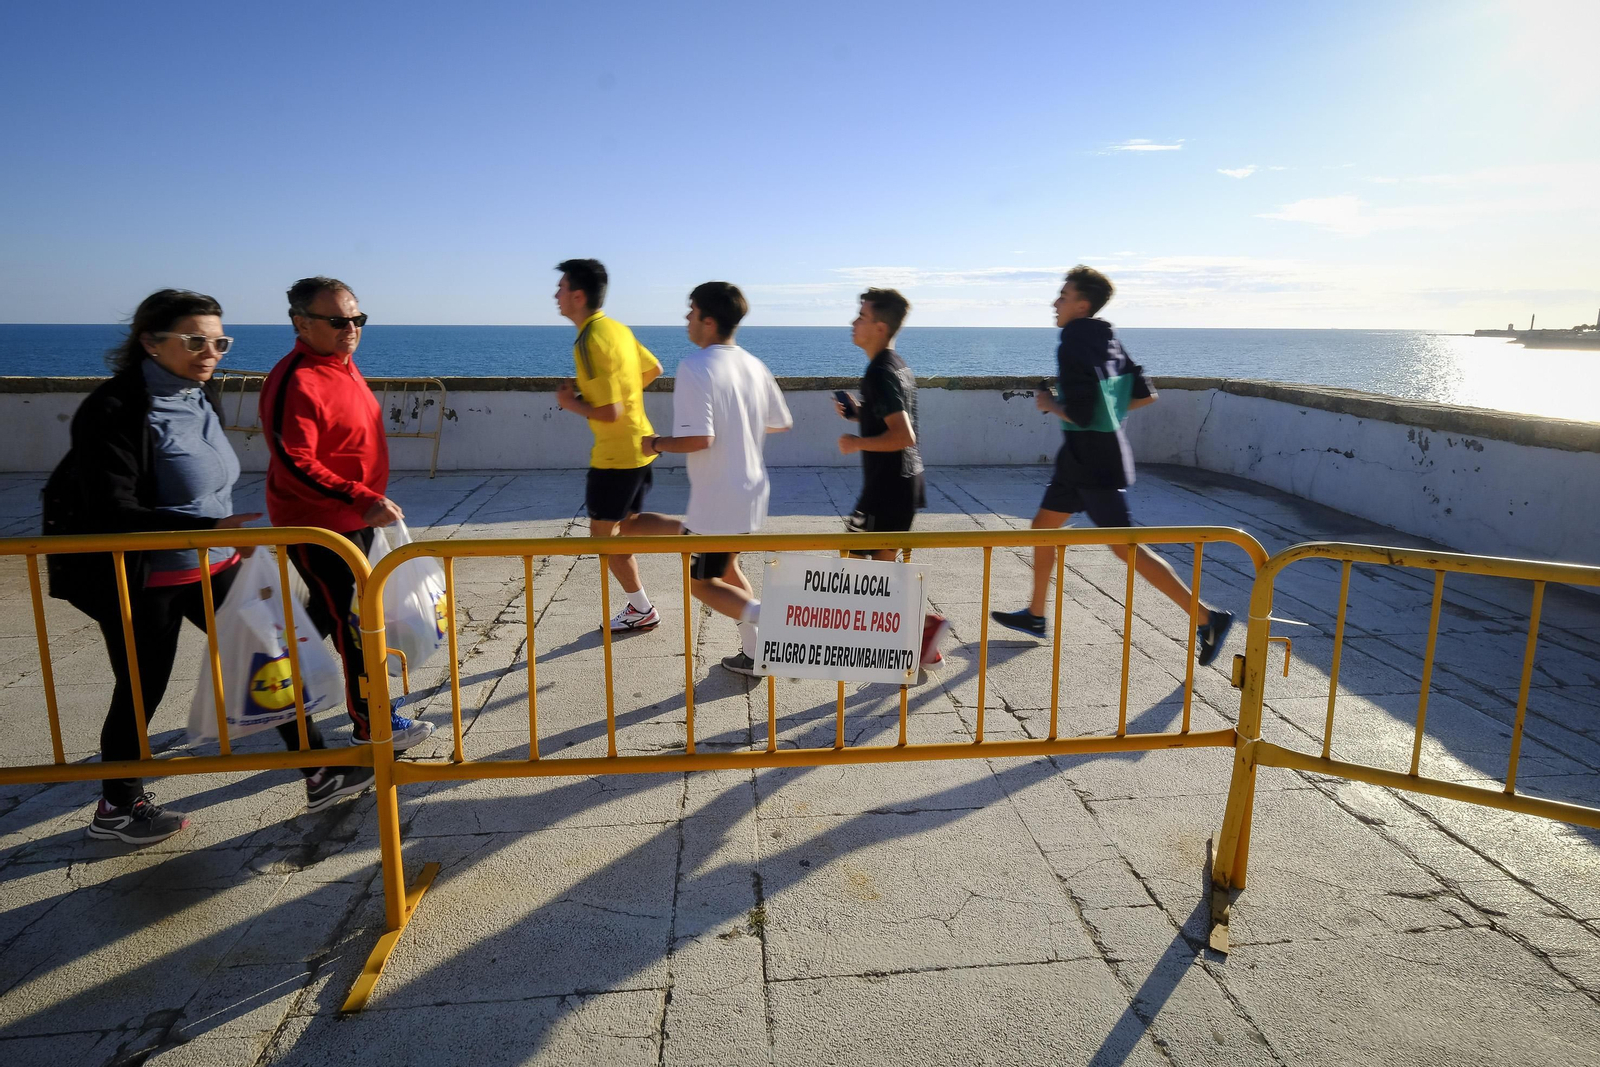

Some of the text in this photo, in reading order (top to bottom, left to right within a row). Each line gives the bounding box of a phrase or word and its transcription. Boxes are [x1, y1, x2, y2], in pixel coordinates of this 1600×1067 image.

[804, 568, 891, 597] POLICÍA LOCAL
[786, 605, 900, 633] PROHIBIDO EL PASO
[763, 641, 913, 669] PELIGRO DE DERRUMBAMIENTO
